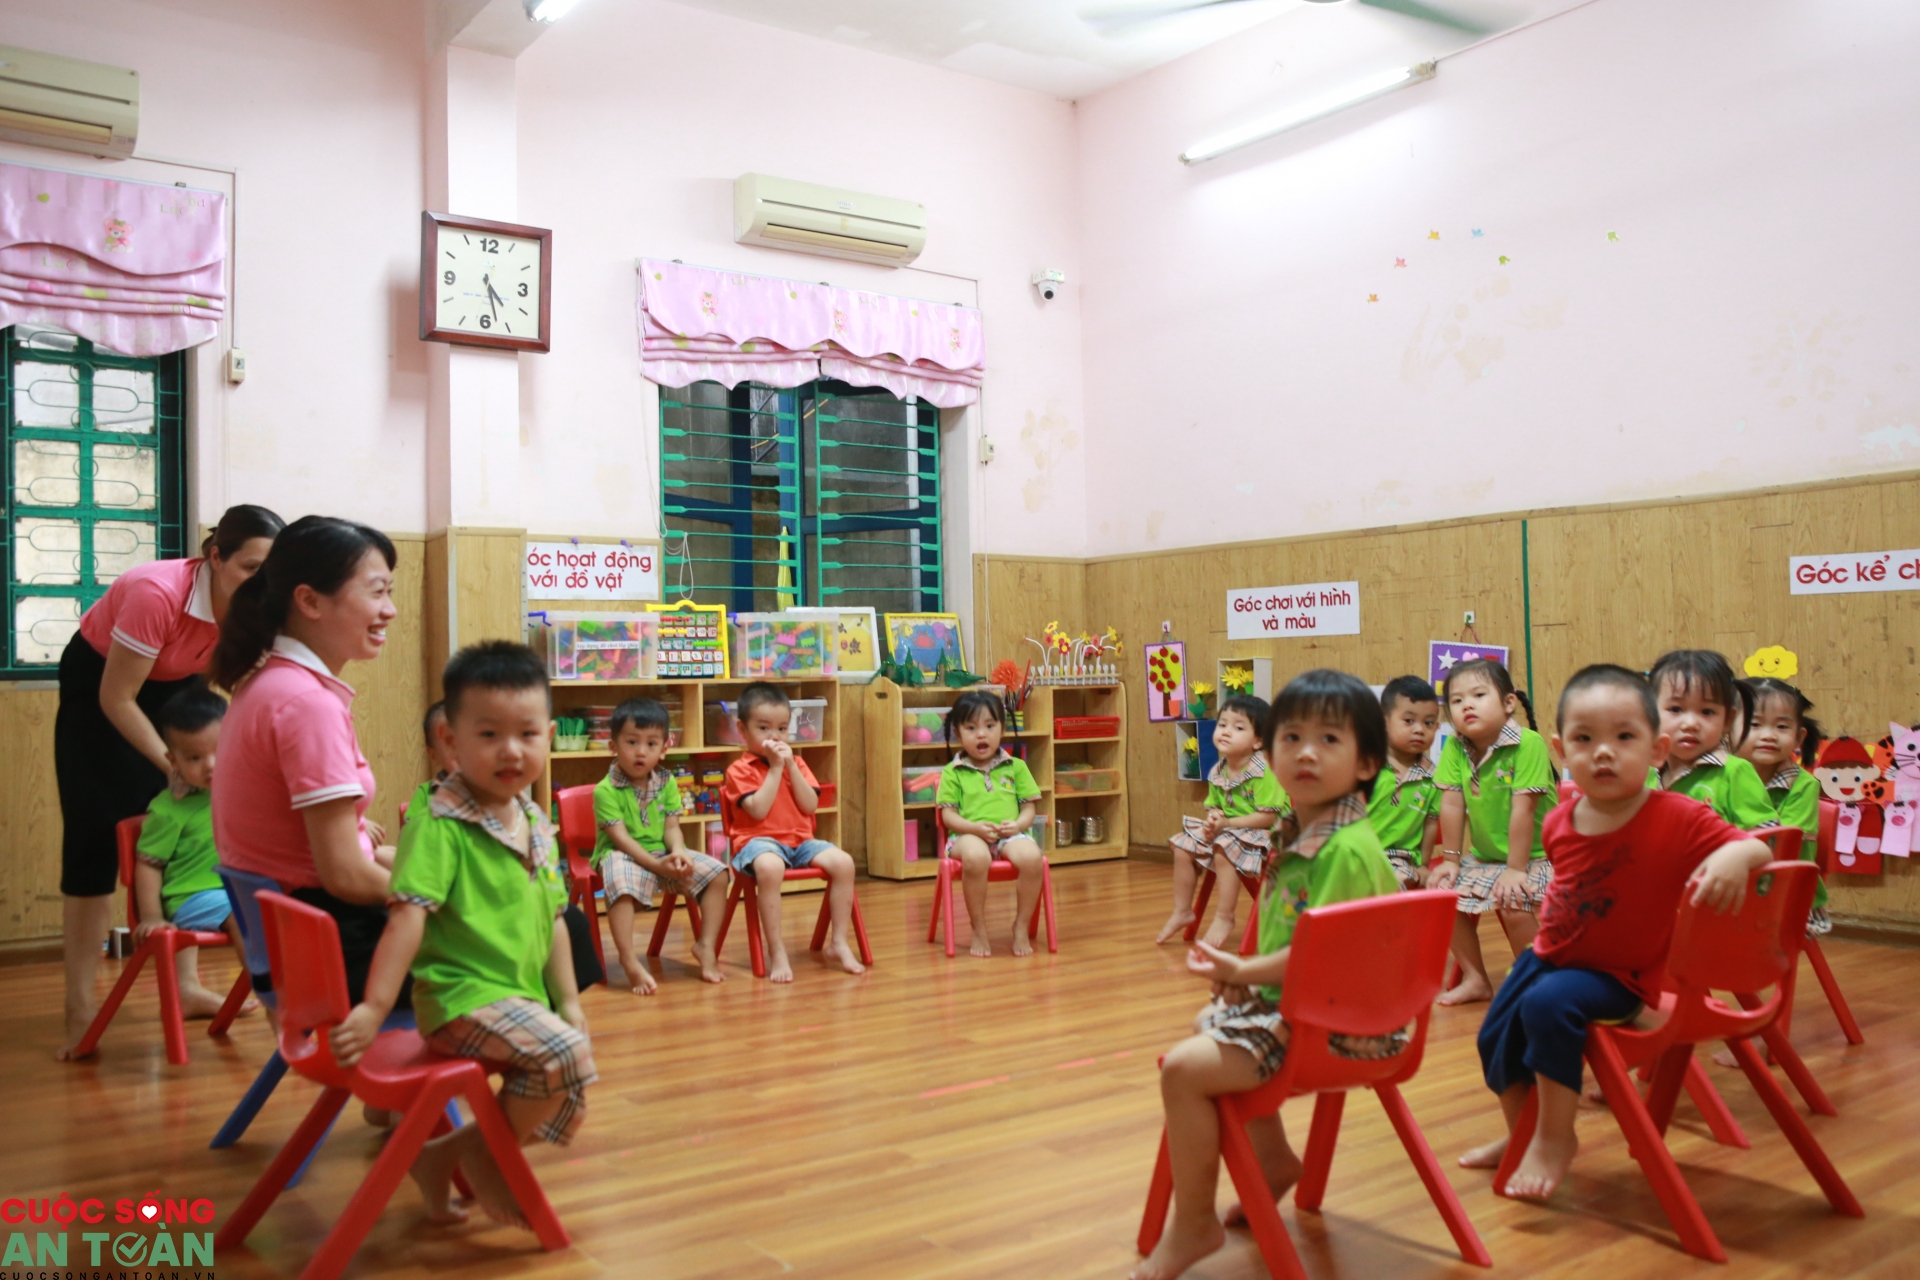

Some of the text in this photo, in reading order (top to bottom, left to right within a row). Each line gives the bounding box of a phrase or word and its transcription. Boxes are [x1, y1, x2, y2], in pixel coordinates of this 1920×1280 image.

[480, 238, 499, 254] 12
[444, 270, 456, 286] 9
[517, 282, 529, 297] 3
[479, 314, 491, 329] 6
[527, 547, 552, 566] óc
[604, 551, 651, 573] động
[1796, 561, 1849, 584] Góc
[1856, 554, 1890, 581] kể
[529, 569, 623, 592] với đồ vật
[1234, 588, 1351, 613] Góc chơi với hình
[1262, 613, 1316, 630] và màu
